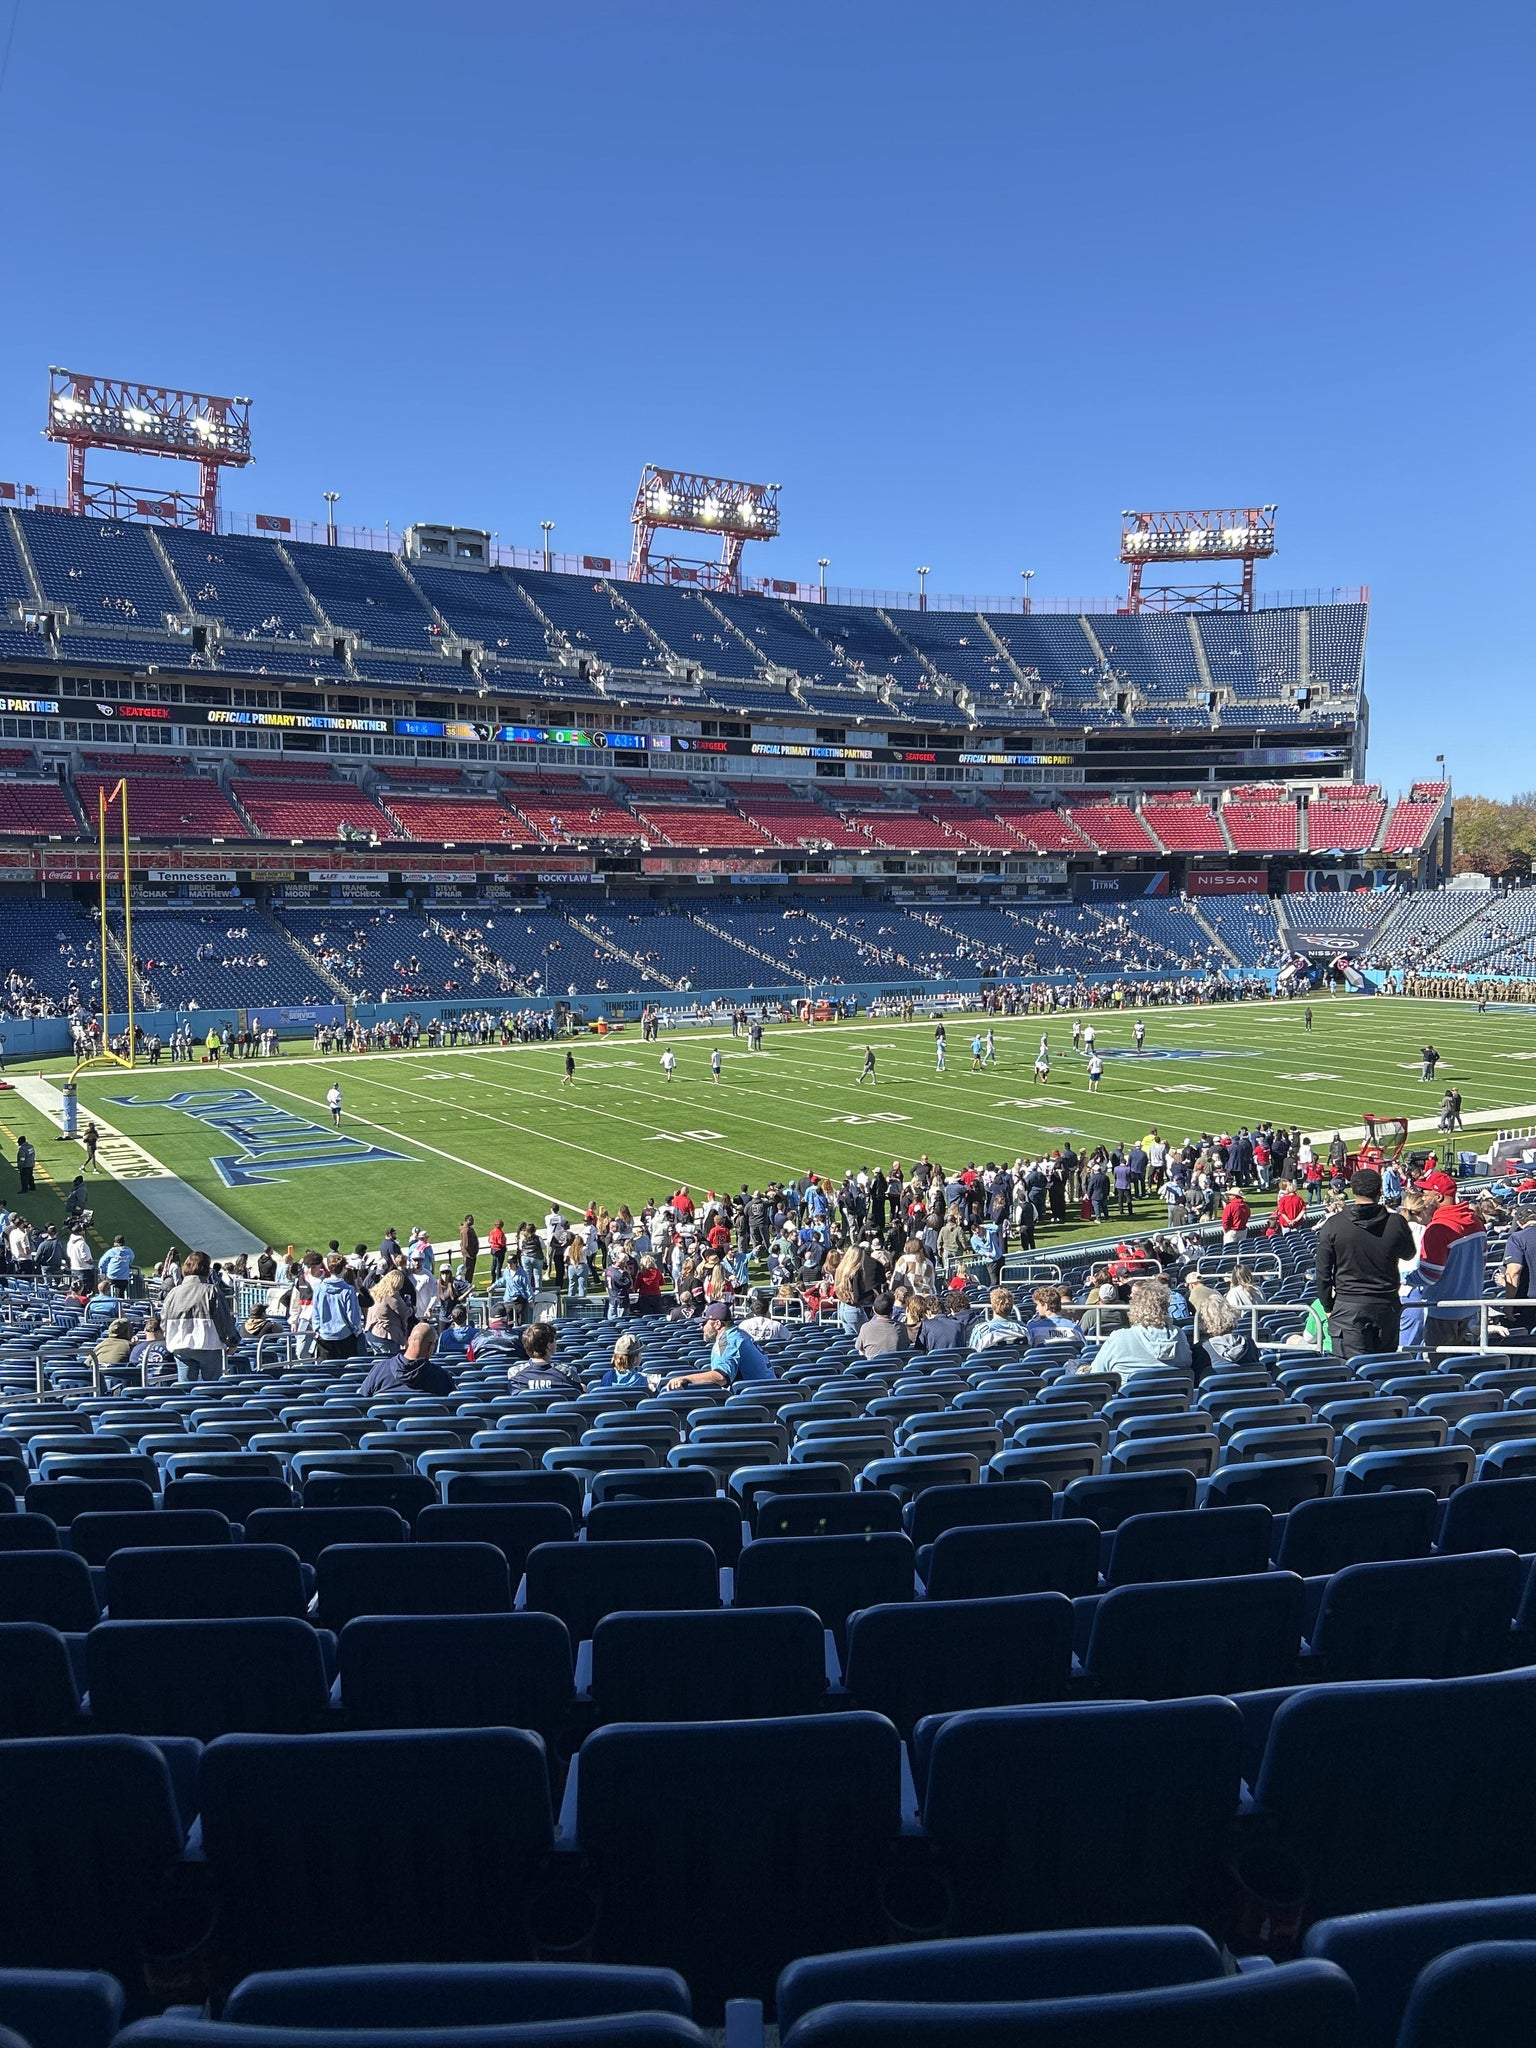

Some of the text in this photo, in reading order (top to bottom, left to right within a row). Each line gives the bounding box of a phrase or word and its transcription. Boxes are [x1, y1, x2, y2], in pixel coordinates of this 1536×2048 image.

[8, 699, 59, 713] PARTNER
[120, 706, 171, 718] SEATGEEK
[208, 710, 388, 732] OFFICIAL PRIMARY TICKETING PARTNER
[405, 723, 419, 733] 1st
[556, 732, 565, 743] 0
[652, 738, 664, 747] 1st
[692, 741, 728, 751] SEATGEEK
[752, 744, 872, 759] OFFICIAL PRIMARY TICKETING PARTNER
[905, 752, 936, 761] SEATGEEK
[959, 754, 987, 764] OFFICIAL
[987, 755, 1017, 764] PRIMARY
[1017, 756, 1053, 765] TICKETING
[494, 874, 517, 882] FedEx
[537, 874, 588, 882] ROCKY LAW
[1197, 876, 1259, 885] NISSAN
[1091, 879, 1120, 890] TITANS
[829, 1111, 913, 1125] 20
[655, 1129, 728, 1143] 10
[1048, 1329, 1068, 1338] YOUNG
